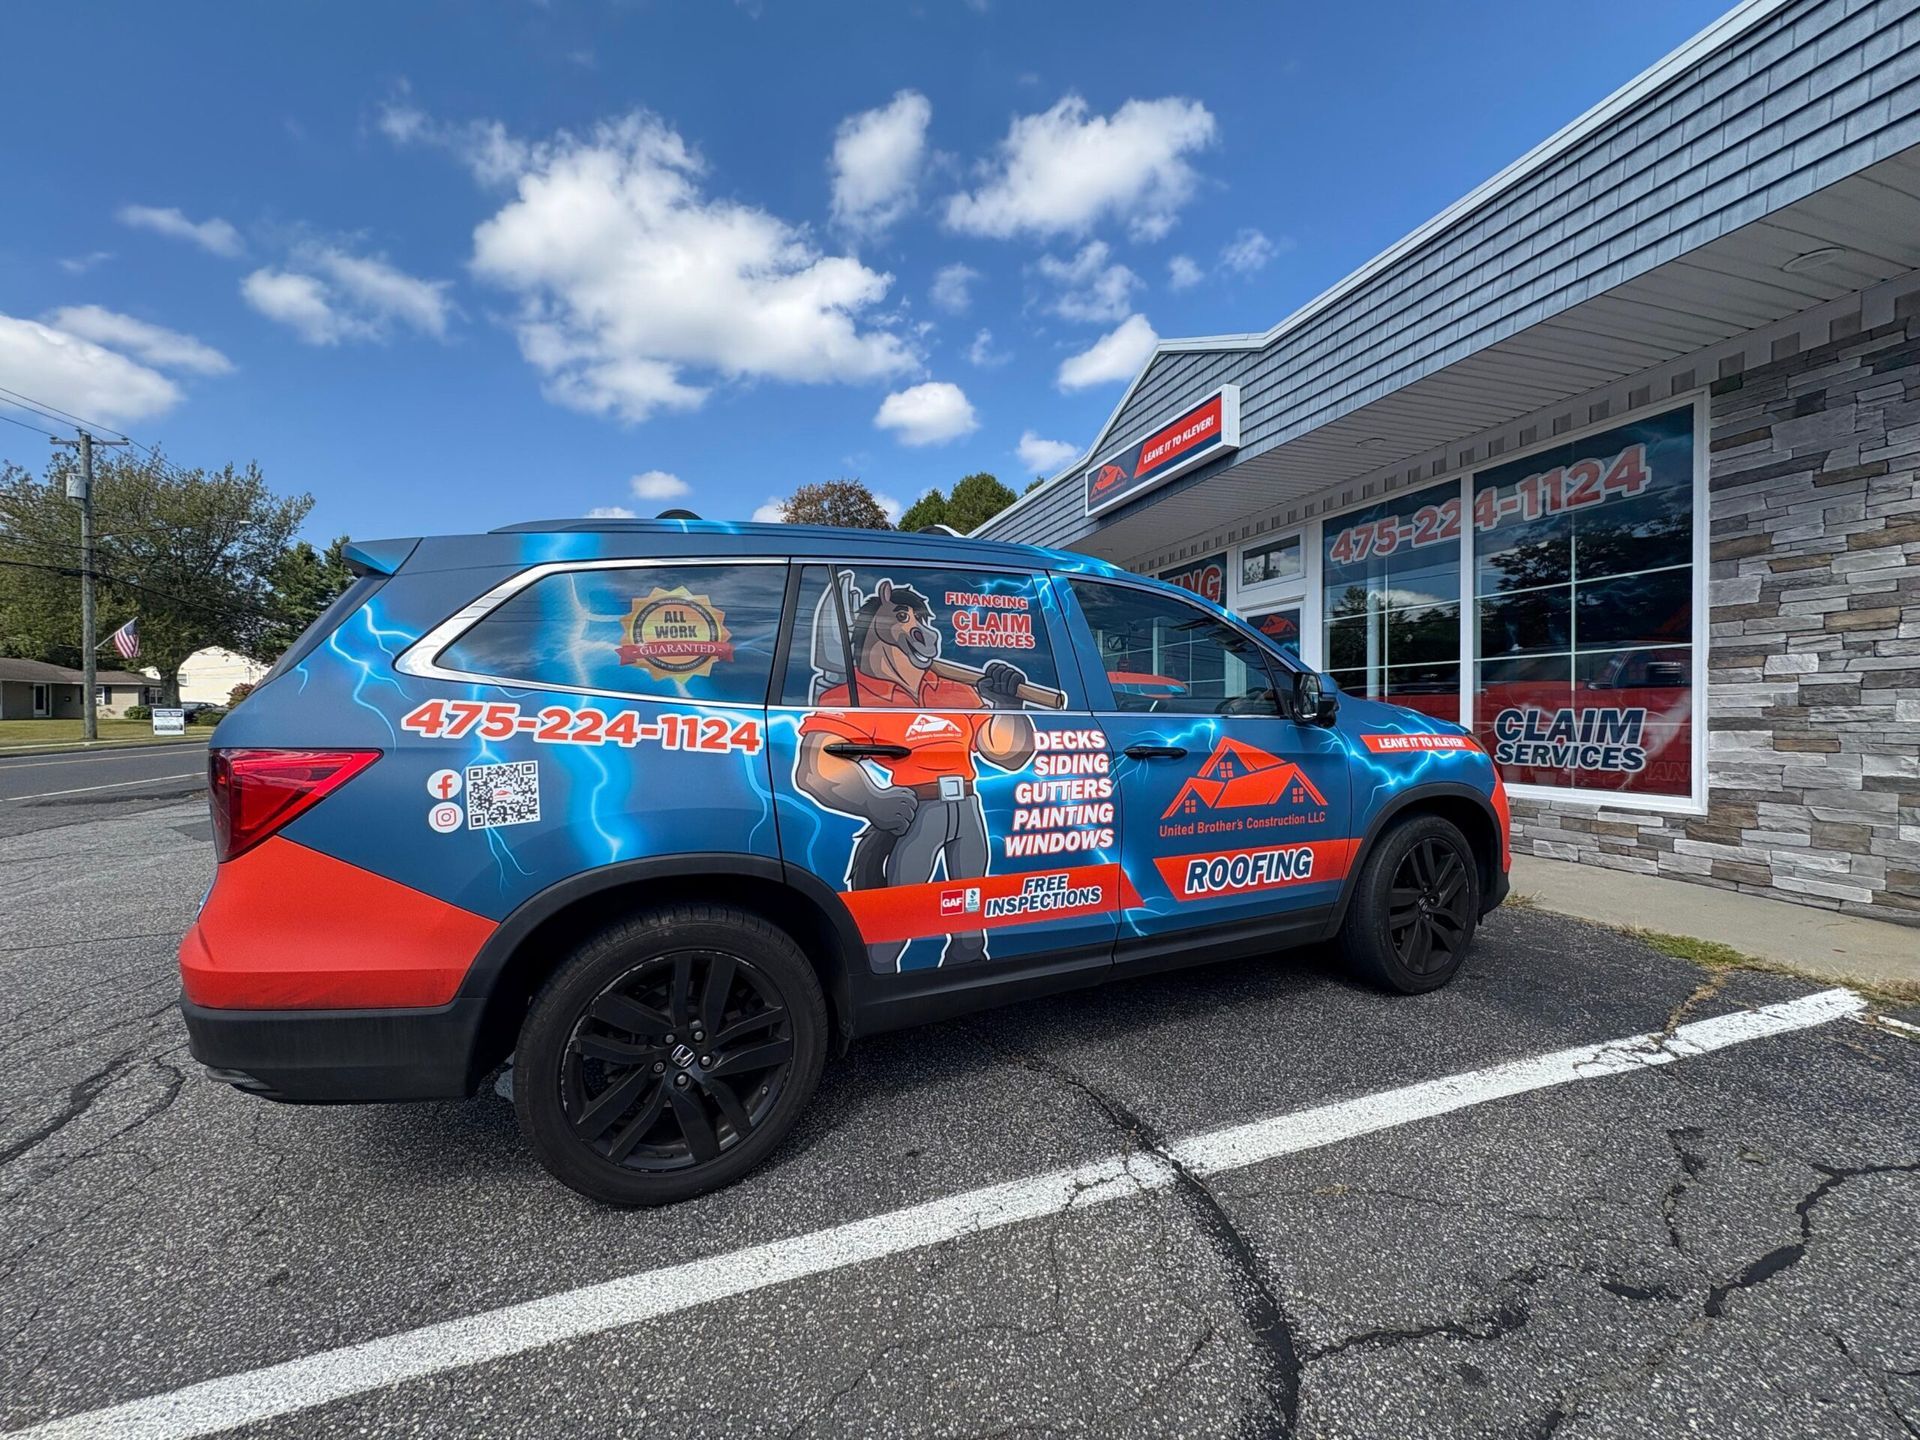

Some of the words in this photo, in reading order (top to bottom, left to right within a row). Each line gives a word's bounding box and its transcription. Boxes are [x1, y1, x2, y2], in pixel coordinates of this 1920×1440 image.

[1143, 446, 1164, 464] LEAVE
[1164, 440, 1172, 452] IT
[1172, 436, 1181, 447] TO
[1182, 415, 1215, 440] KLEVER!
[945, 592, 1028, 609] FINANCING
[664, 611, 686, 623] ALL
[952, 610, 1031, 634] CLAIM
[654, 625, 697, 639] WORK
[955, 631, 1035, 648] SERVICES
[403, 700, 763, 753] 475-224-1124
[1495, 708, 1647, 746] CLAIM
[1033, 730, 1106, 750] DECKS
[1378, 738, 1409, 748] LEAVE
[1409, 737, 1419, 748] IT
[1419, 737, 1431, 747] TO
[1034, 753, 1109, 776] SIDING
[1494, 742, 1646, 772] SERVICES
[1015, 778, 1113, 804] GUTTERS
[1012, 802, 1114, 831] PAINTING
[1159, 822, 1194, 837] United
[1197, 818, 1243, 834] Brother's
[1246, 813, 1305, 829] Construction
[1308, 811, 1326, 823] LLC
[1004, 828, 1115, 858] WINDOWS
[1184, 847, 1314, 894] ROOFING
[1022, 873, 1069, 895] FREE
[942, 900, 962, 908] GAF
[984, 887, 1102, 918] INSPECTIONS
